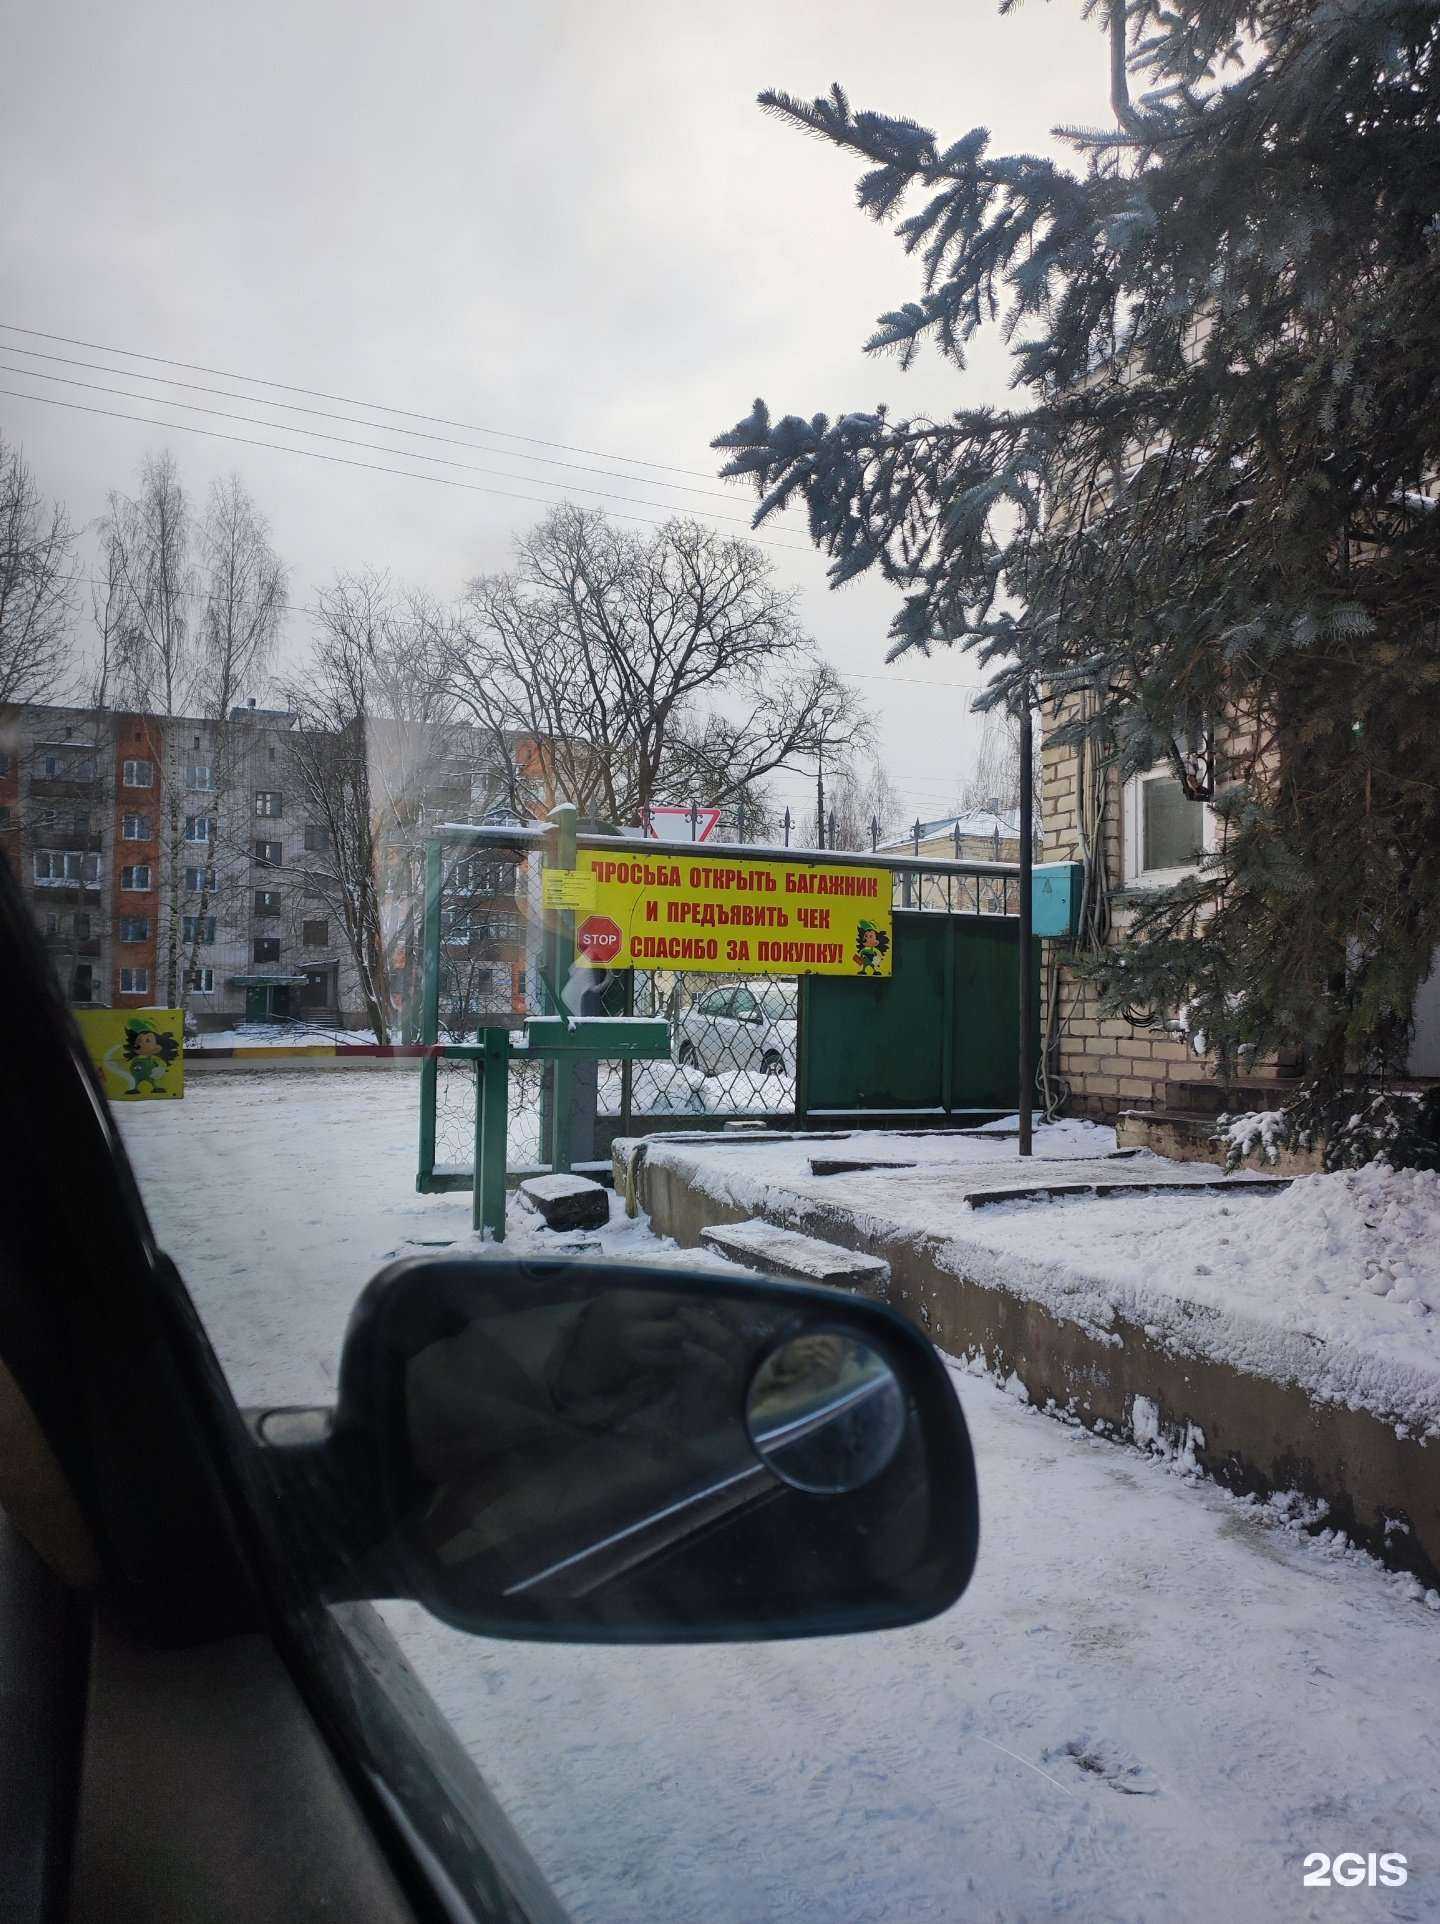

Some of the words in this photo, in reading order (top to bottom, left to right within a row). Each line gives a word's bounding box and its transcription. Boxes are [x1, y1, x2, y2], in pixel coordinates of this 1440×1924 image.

[689, 867, 777, 892] ОТКРЫТЬ
[785, 873, 878, 898] БАГАЖНИК
[646, 901, 658, 921] И
[667, 901, 789, 928] ПРЕДЪЯВИТЬ
[797, 908, 830, 929] ЧЕК
[583, 934, 617, 945] STOP
[630, 935, 718, 960] СПАСИБО
[726, 940, 750, 961] ЗА
[758, 941, 844, 964] ПОКУПКУ!
